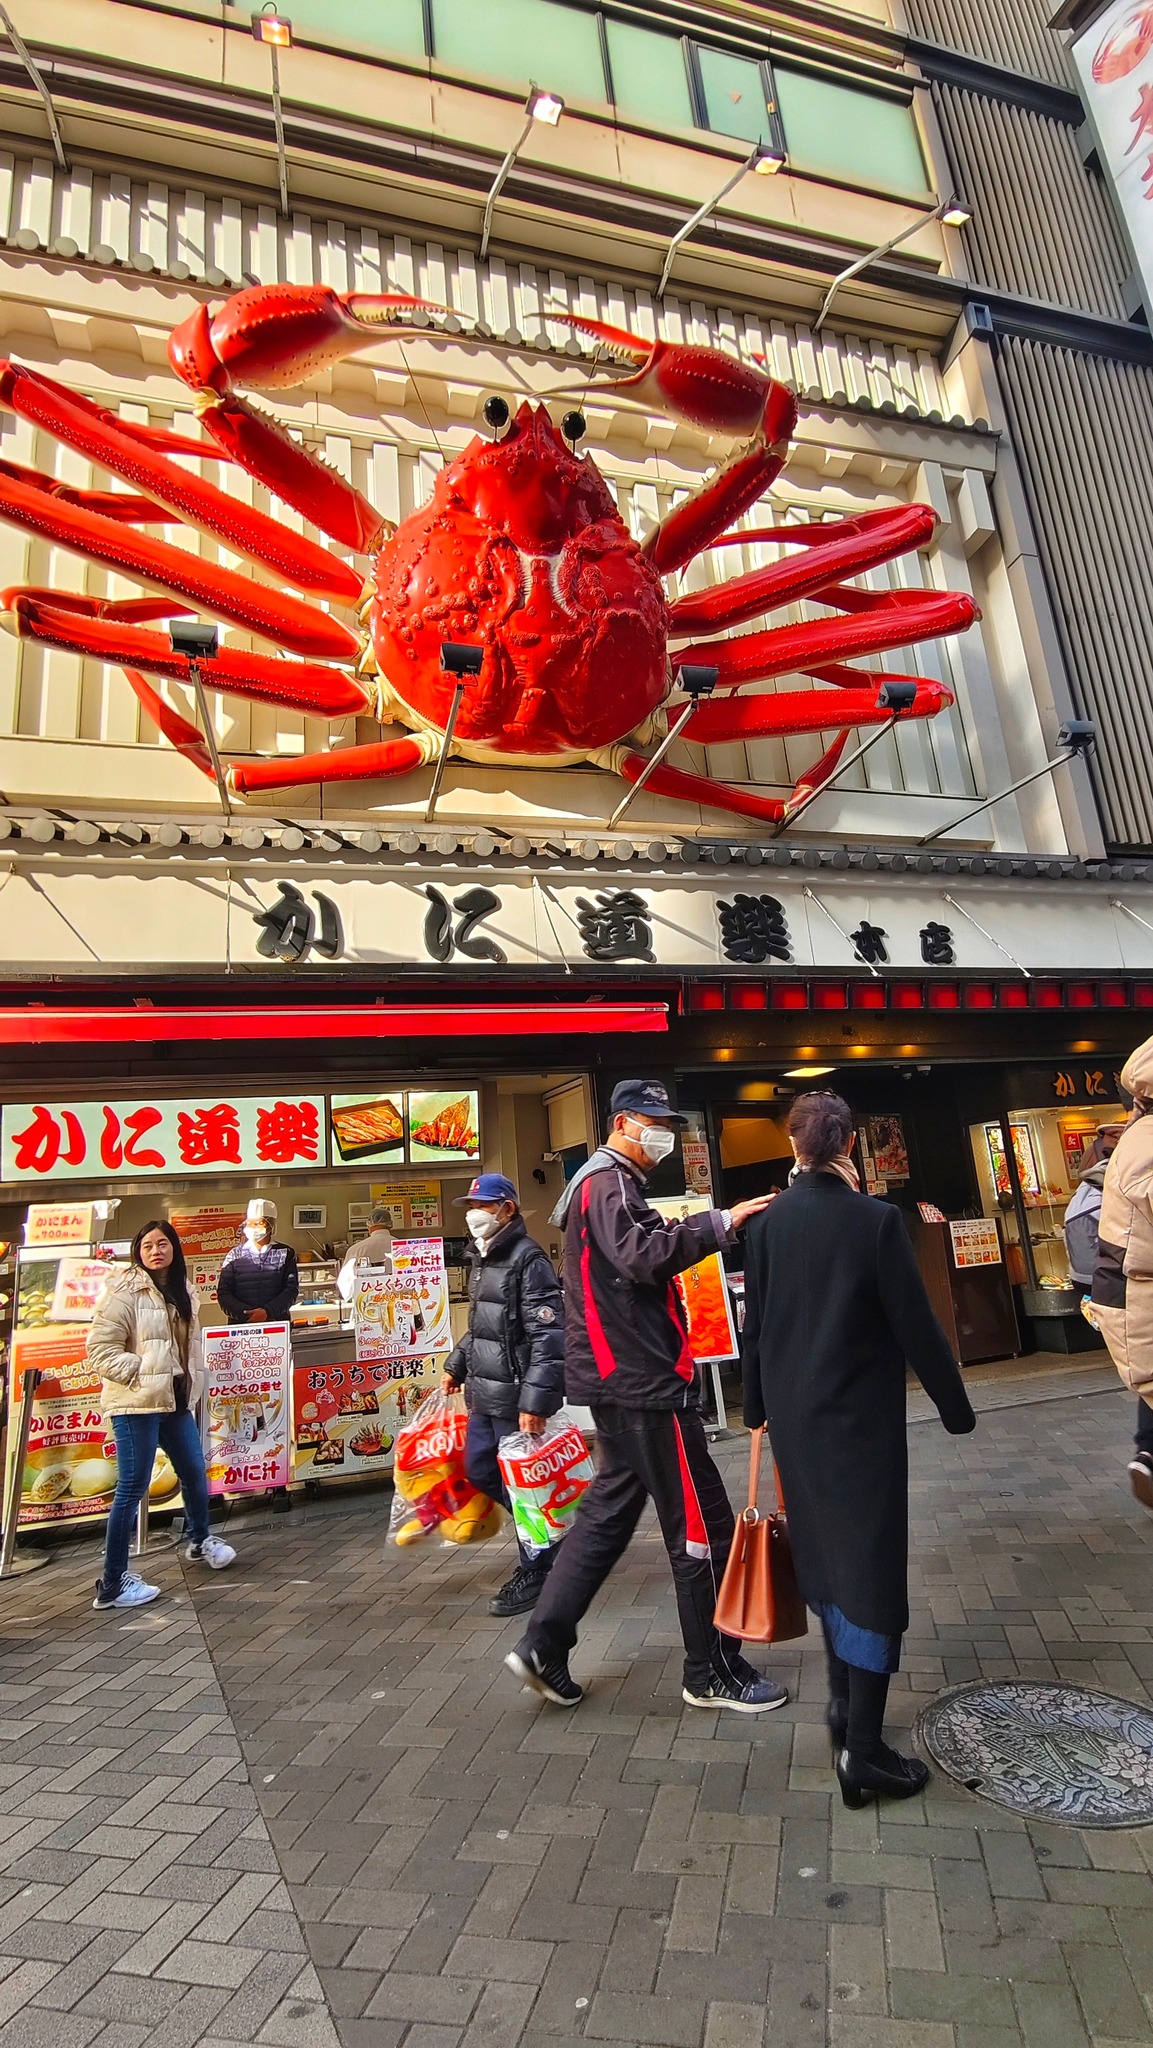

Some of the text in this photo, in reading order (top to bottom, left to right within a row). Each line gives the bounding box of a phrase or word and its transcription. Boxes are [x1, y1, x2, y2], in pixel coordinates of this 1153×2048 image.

[853, 920, 954, 964] 本店
[11, 1101, 319, 1173] かに道樂
[35, 1215, 83, 1228] かにまん
[410, 1254, 442, 1266] かに汁
[361, 1275, 442, 1292] ひとくちの幸せ
[220, 1336, 270, 1350] セット価格
[308, 1358, 437, 1389] おうちで道楽!
[209, 1380, 282, 1397] ひとくちの幸せ
[224, 1461, 280, 1484] かに汁
